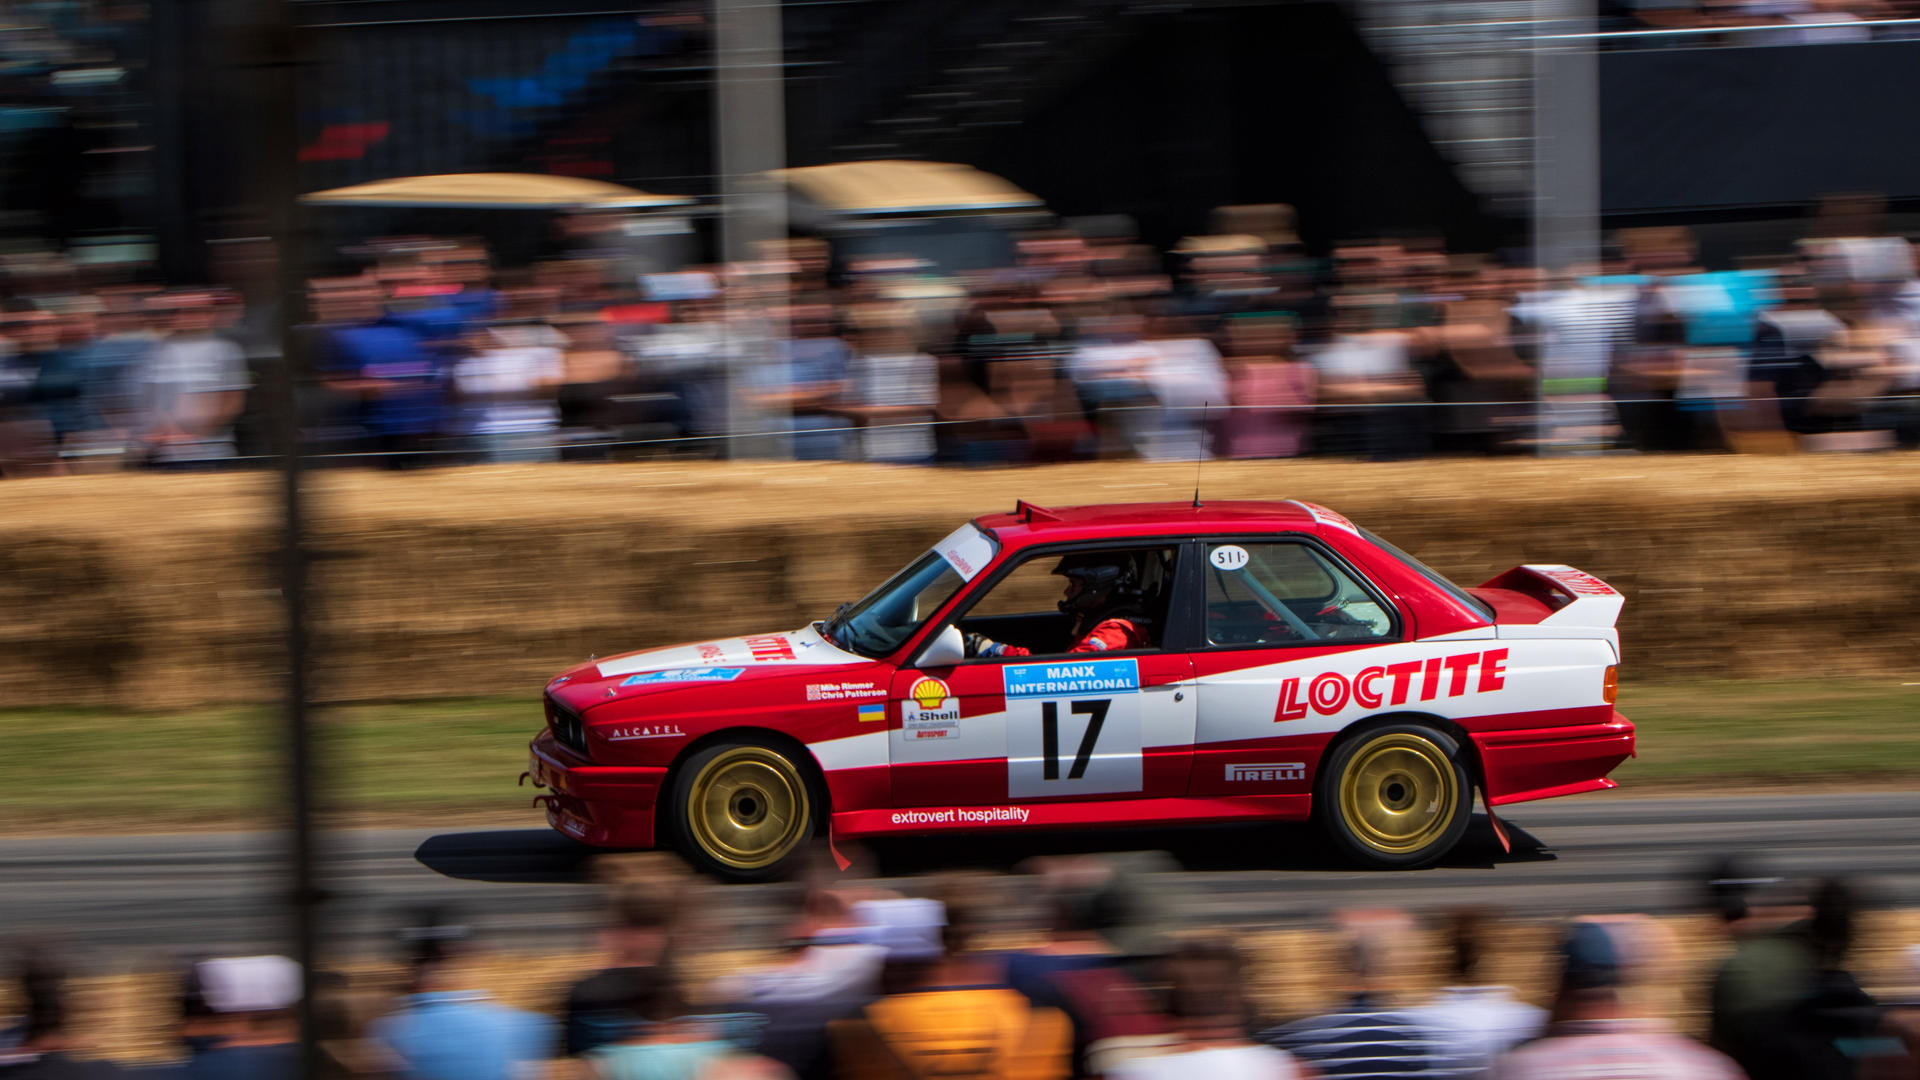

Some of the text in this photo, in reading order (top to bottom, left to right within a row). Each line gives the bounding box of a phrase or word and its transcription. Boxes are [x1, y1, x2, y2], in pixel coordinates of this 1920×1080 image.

[1217, 551, 1242, 564] 511
[1046, 665, 1096, 679] MANX
[1010, 678, 1135, 694] INTERNATIONAL
[1273, 648, 1509, 723] LOCTITE
[821, 689, 888, 700] Chris Patterson
[919, 711, 958, 721] Shell
[613, 725, 681, 737] ALCATEL
[1042, 699, 1112, 780] 17
[1225, 763, 1306, 781] PIRELLI
[891, 807, 1030, 824] extrovert hospitality
